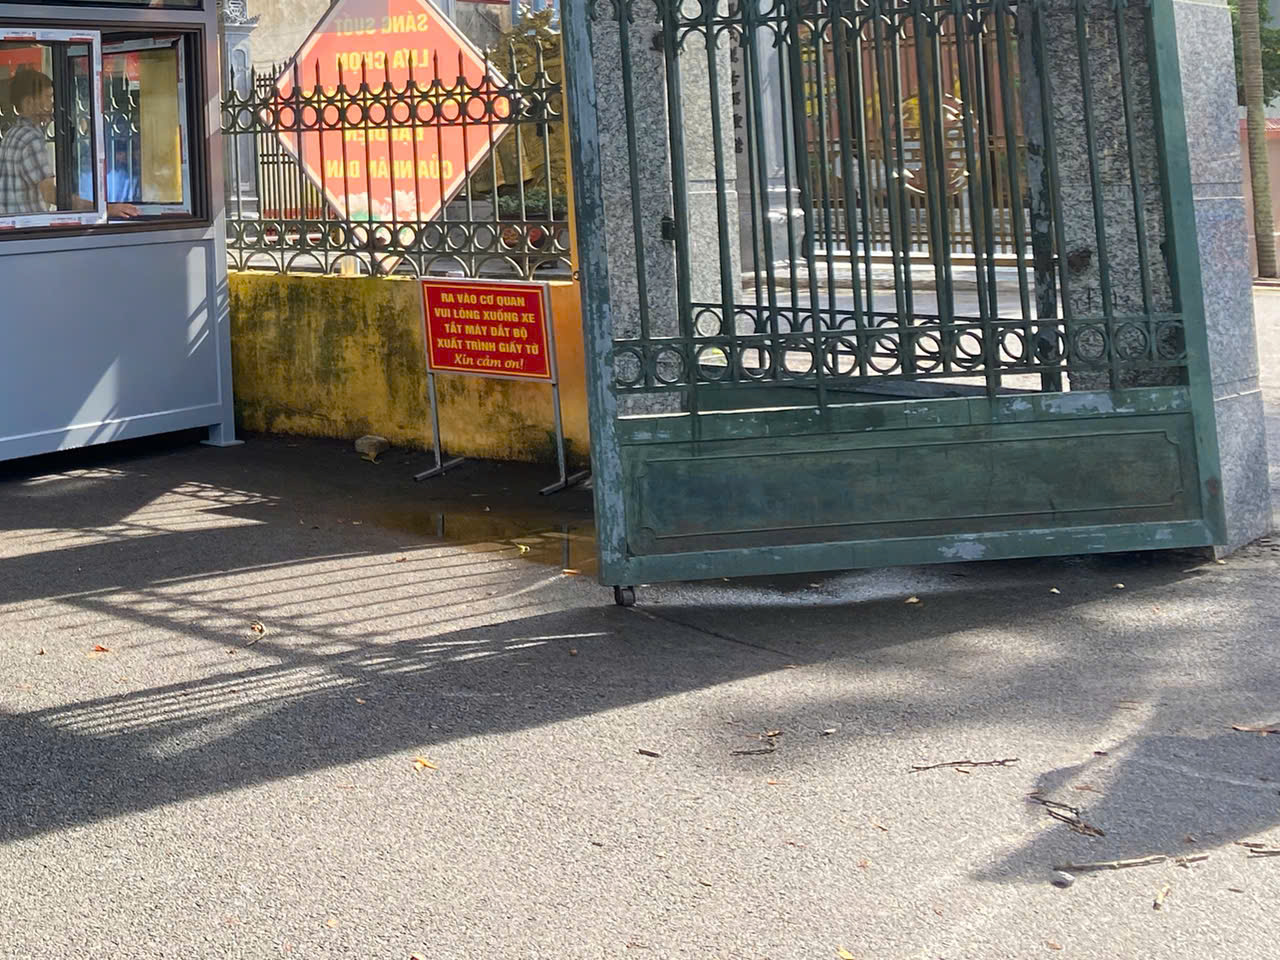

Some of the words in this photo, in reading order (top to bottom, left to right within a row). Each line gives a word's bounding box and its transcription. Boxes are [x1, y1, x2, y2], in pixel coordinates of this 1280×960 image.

[441, 293, 455, 304] RA
[457, 292, 477, 305] VÀO
[480, 294, 494, 306] CƠ
[497, 295, 526, 307] QUAN
[434, 307, 451, 318] VUI
[454, 307, 481, 320] LÒNG
[483, 308, 519, 322] XUỐNG
[521, 313, 536, 323] XE
[465, 323, 488, 336] MÁY
[513, 326, 528, 341] BỘ
[437, 337, 463, 350] XUẤT
[466, 338, 496, 352] TRÌNH
[498, 339, 523, 354] GIẤY
[454, 353, 474, 366] Xin
[476, 355, 502, 368] cảm
